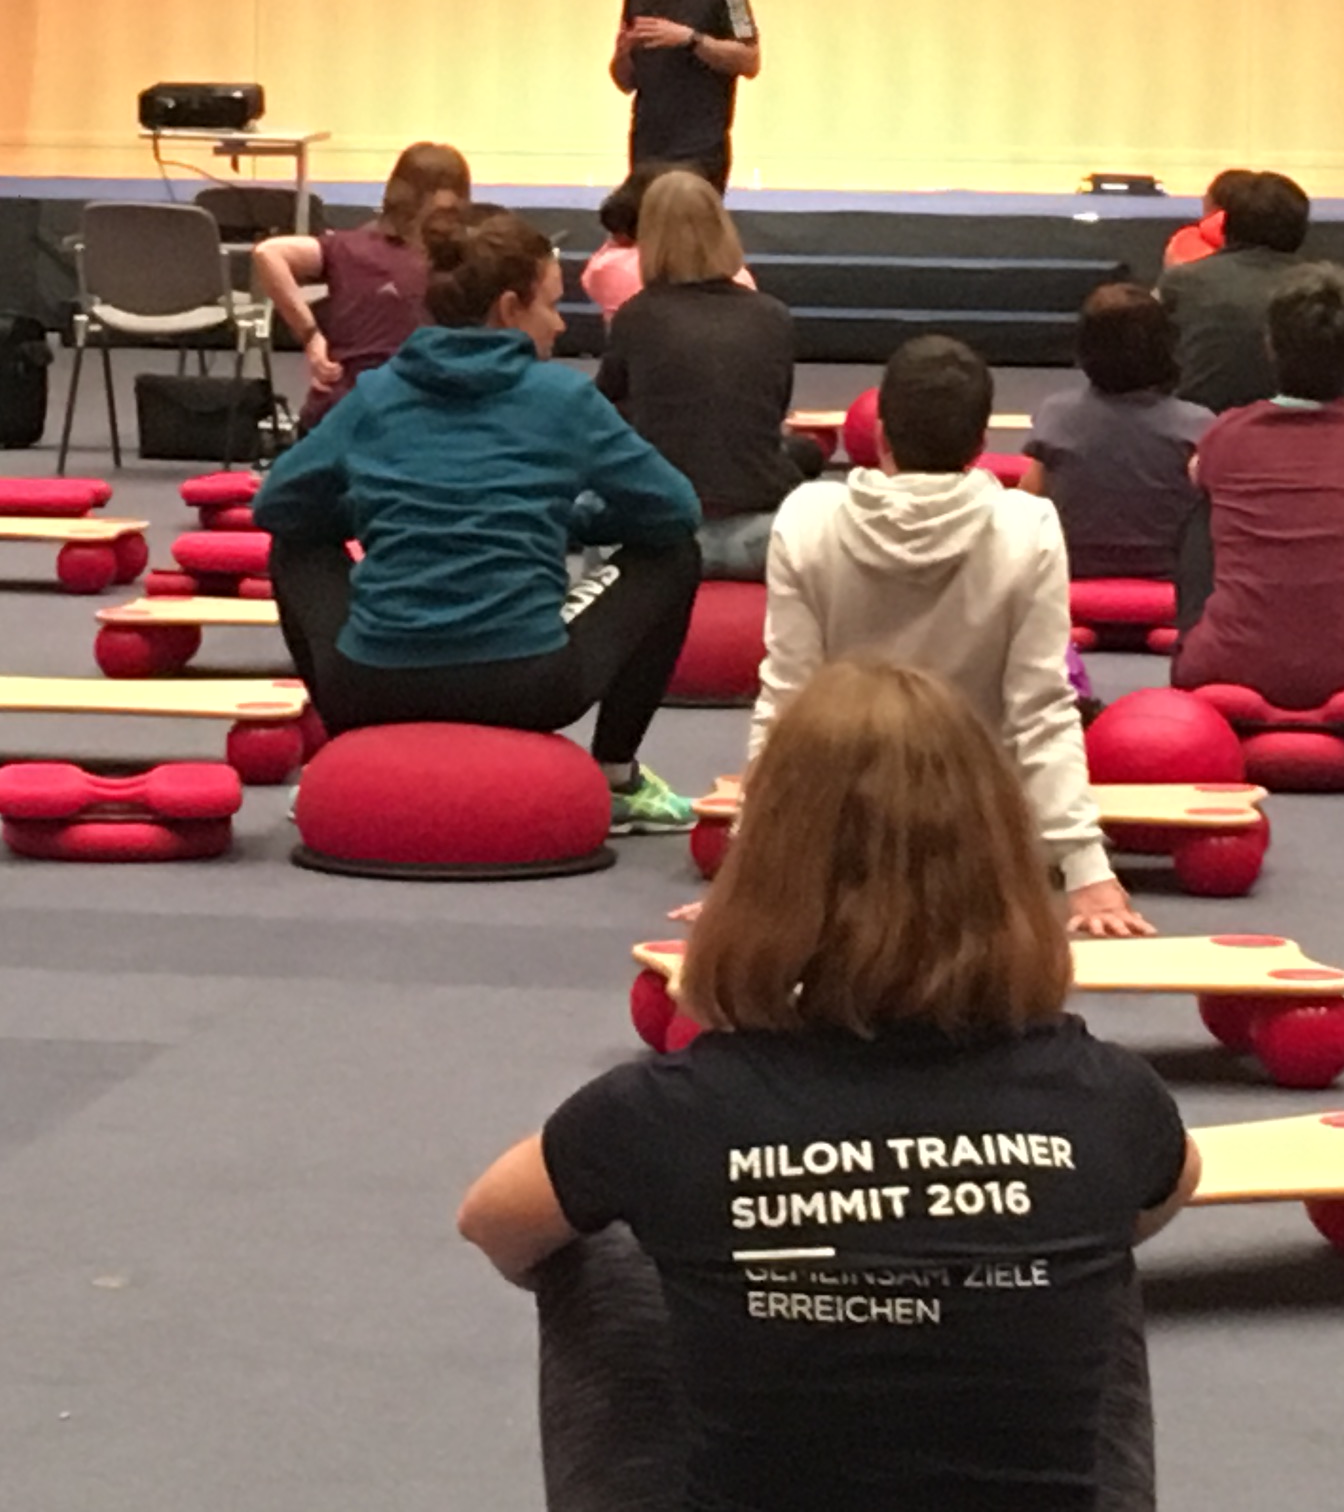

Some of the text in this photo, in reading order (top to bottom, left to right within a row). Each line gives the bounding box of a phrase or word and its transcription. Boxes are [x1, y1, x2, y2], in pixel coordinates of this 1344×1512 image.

[728, 1133, 1076, 1182] MILON TRAINER
[730, 1180, 1032, 1229] SUMMIT 2016
[963, 1259, 1051, 1287] ZIELE
[747, 1290, 941, 1325] ERREICHEN
